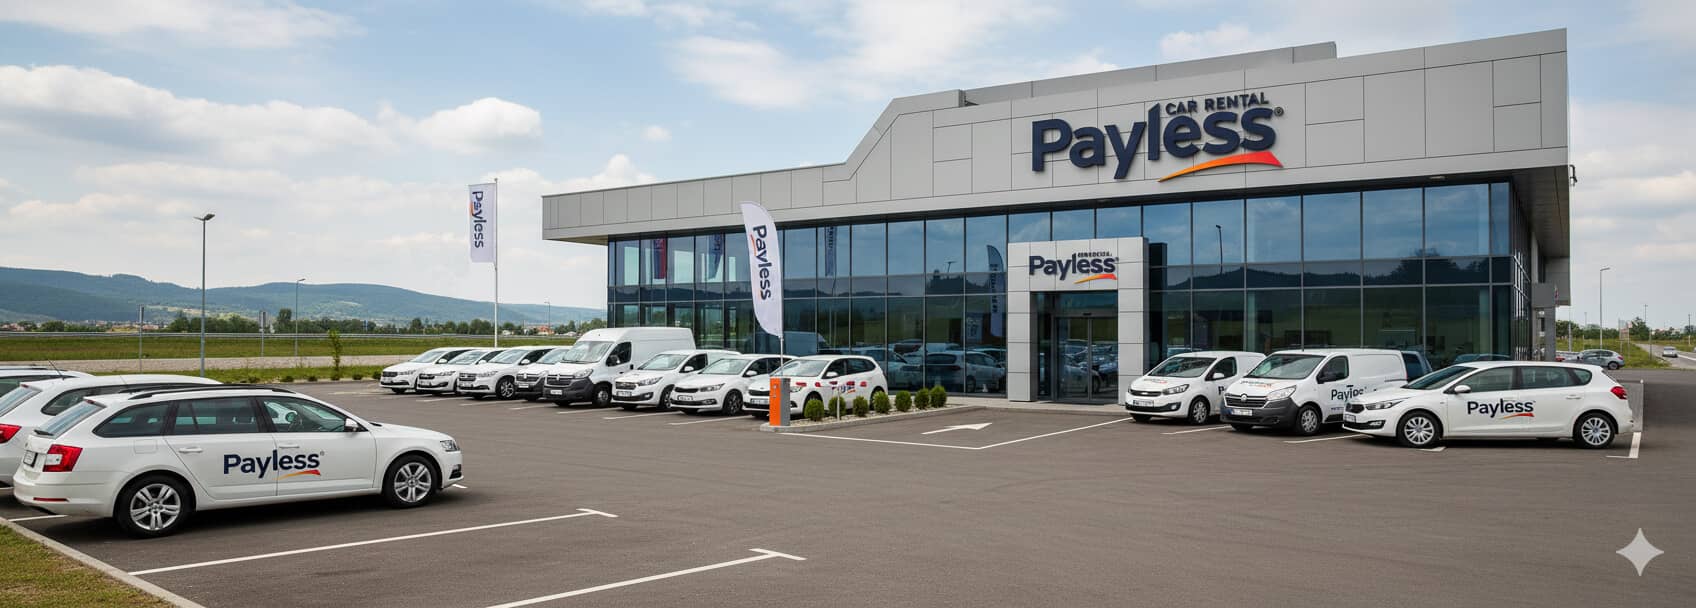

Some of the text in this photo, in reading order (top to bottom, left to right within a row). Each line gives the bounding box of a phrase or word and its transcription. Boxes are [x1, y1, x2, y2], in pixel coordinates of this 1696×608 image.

[1165, 92, 1270, 116] CAR RENTAL
[472, 191, 487, 249] Payless
[1029, 252, 1117, 281] Payless
[1467, 398, 1534, 418] Payless
